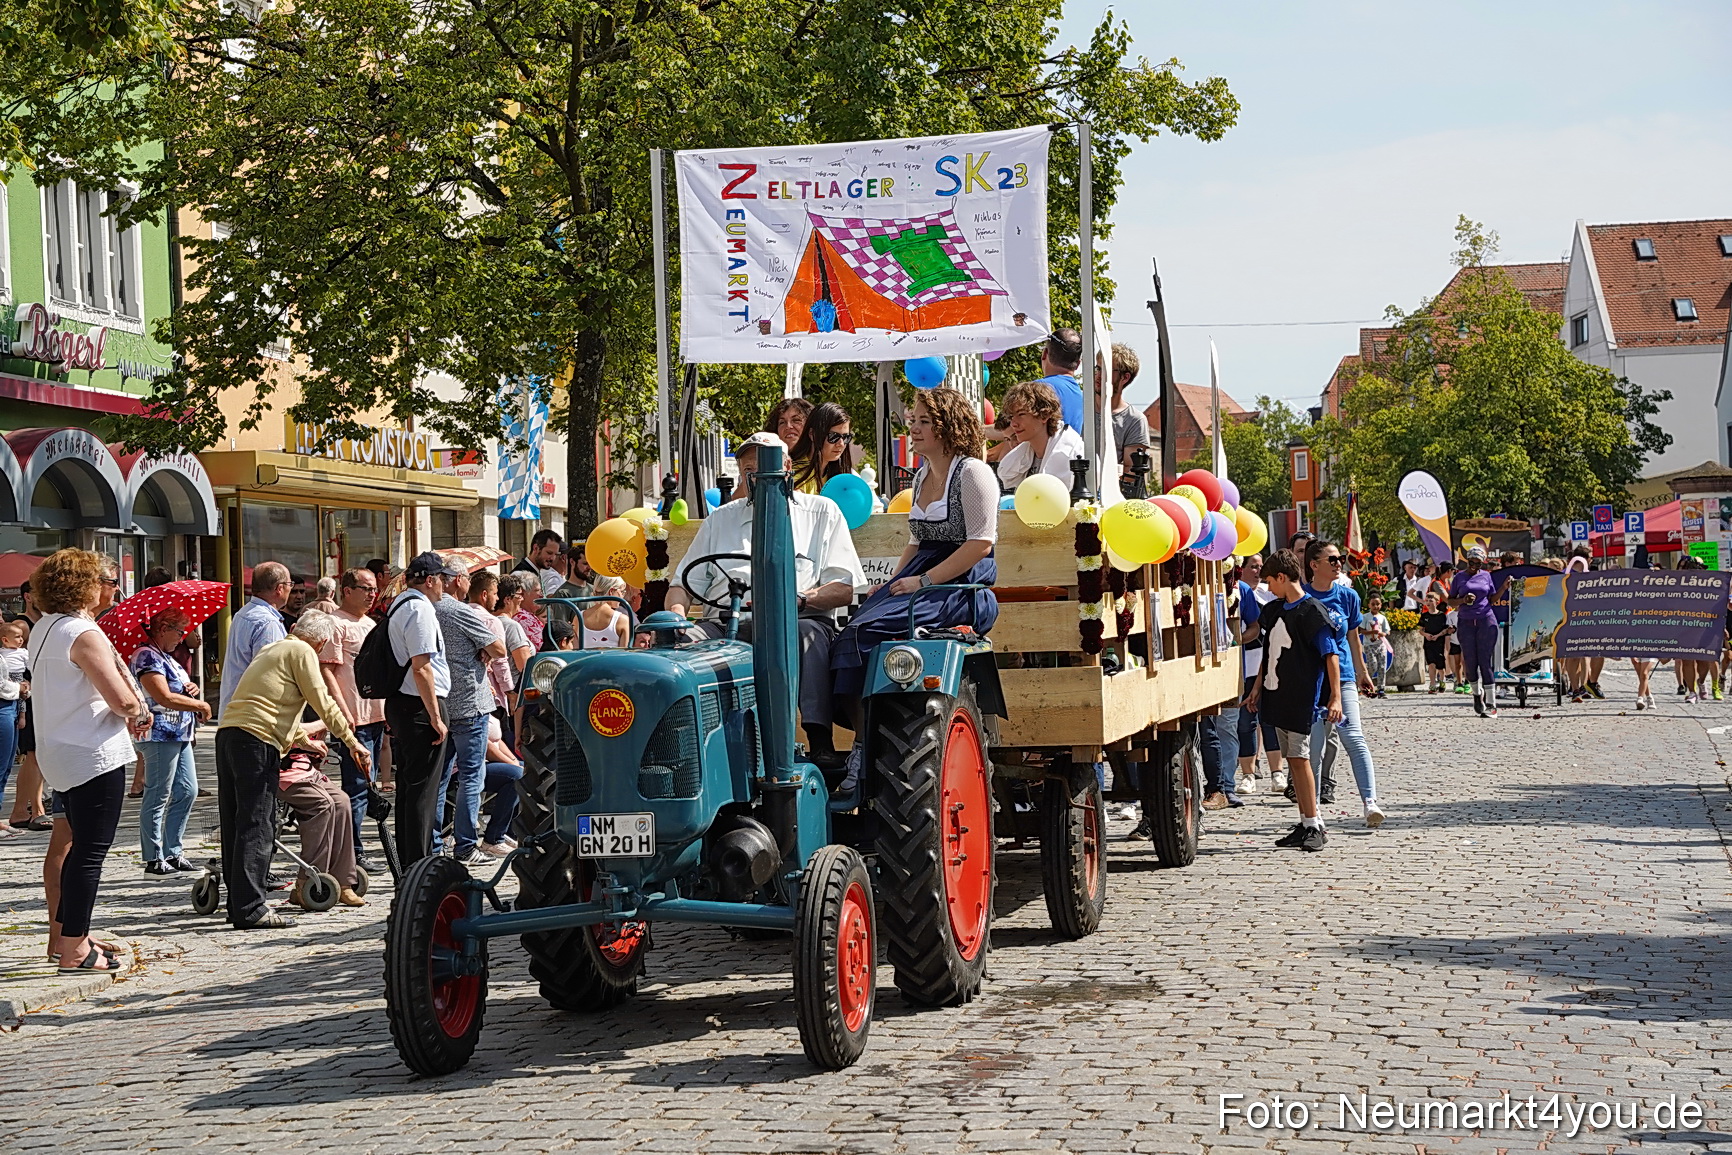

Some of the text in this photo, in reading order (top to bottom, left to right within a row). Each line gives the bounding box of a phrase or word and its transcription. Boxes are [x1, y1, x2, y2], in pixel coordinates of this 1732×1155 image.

[15, 302, 108, 373] Bögerl
[456, 469, 479, 477] family
[1629, 514, 1640, 531] P
[1575, 524, 1585, 539] P
[1577, 577, 1630, 590] parkrun
[1642, 575, 1677, 586] freie
[1680, 575, 1722, 587] Läufe
[1599, 591, 1633, 599] Samstag
[1635, 591, 1666, 599] Morgen
[1682, 591, 1702, 599] 9.00
[1618, 608, 1632, 616] die
[1633, 609, 1718, 619] Landesgartenschau
[1569, 618, 1713, 628] laufen, walken, gehen oder helfen!
[597, 708, 625, 718] LANZ
[591, 817, 615, 835] NM
[580, 835, 651, 854] GN 20 H
